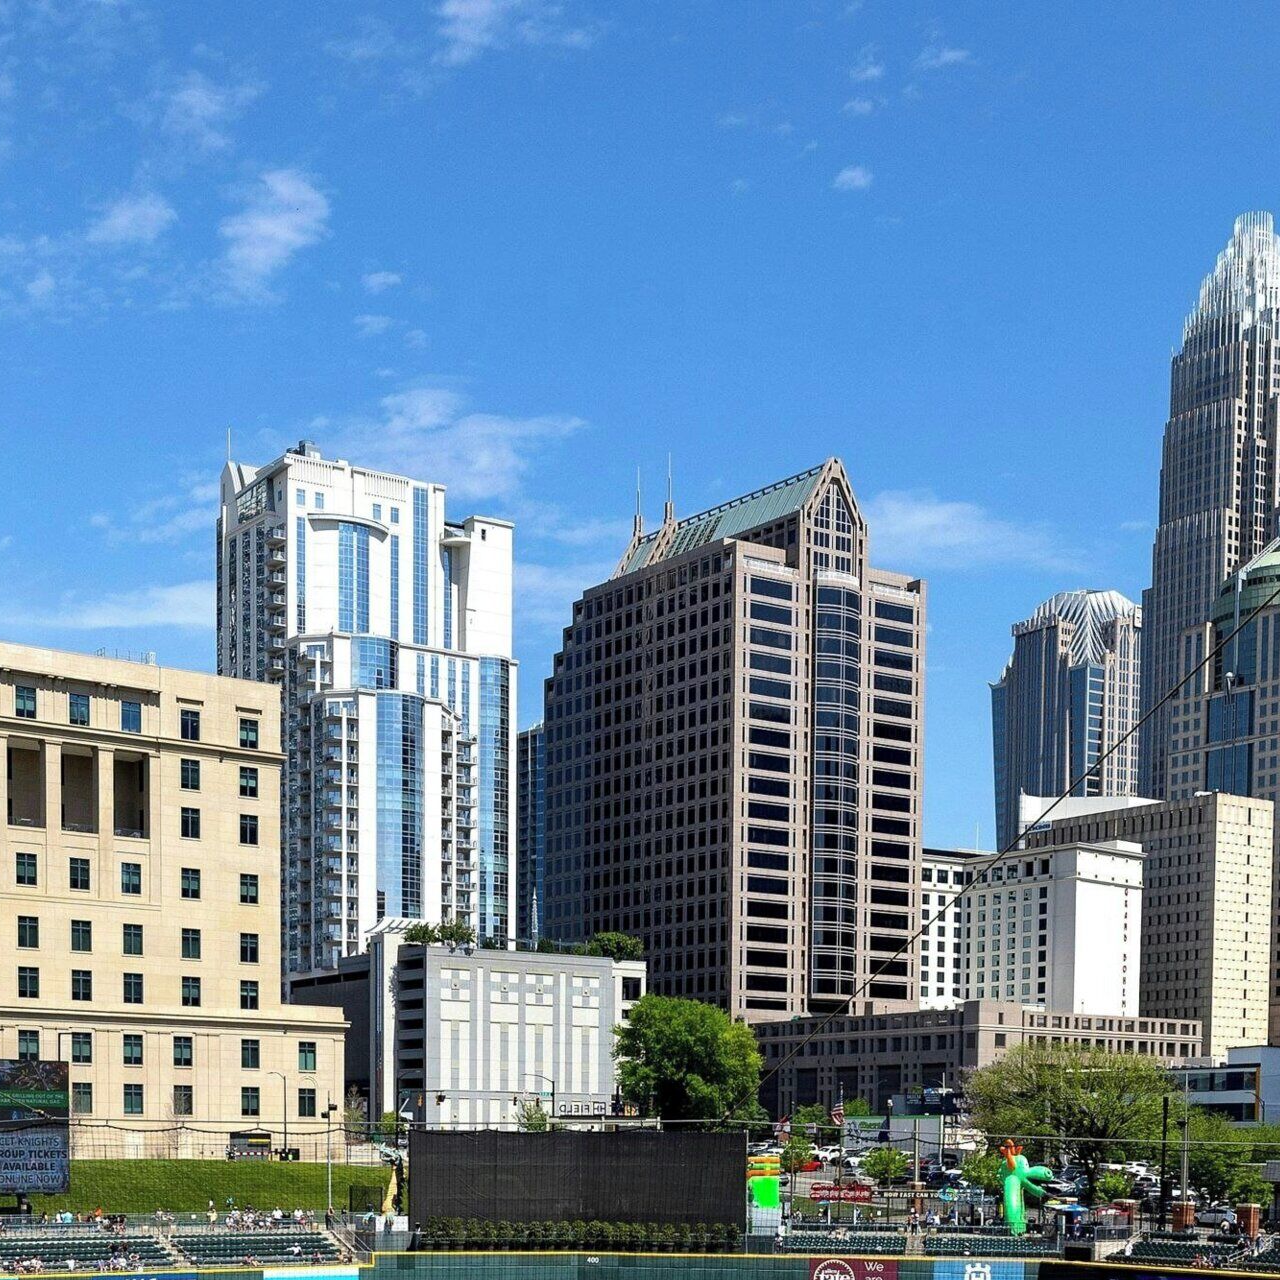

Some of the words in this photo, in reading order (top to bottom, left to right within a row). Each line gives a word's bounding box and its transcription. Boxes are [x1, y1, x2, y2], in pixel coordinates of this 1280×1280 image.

[0, 1137, 15, 1146] CLT
[19, 1137, 60, 1146] KNIGHTS
[29, 1150, 68, 1158] TICKETS
[2, 1163, 56, 1171] AVAILABLE
[37, 1174, 60, 1183] NOW
[586, 1256, 600, 1264] 400
[864, 1261, 884, 1272] We
